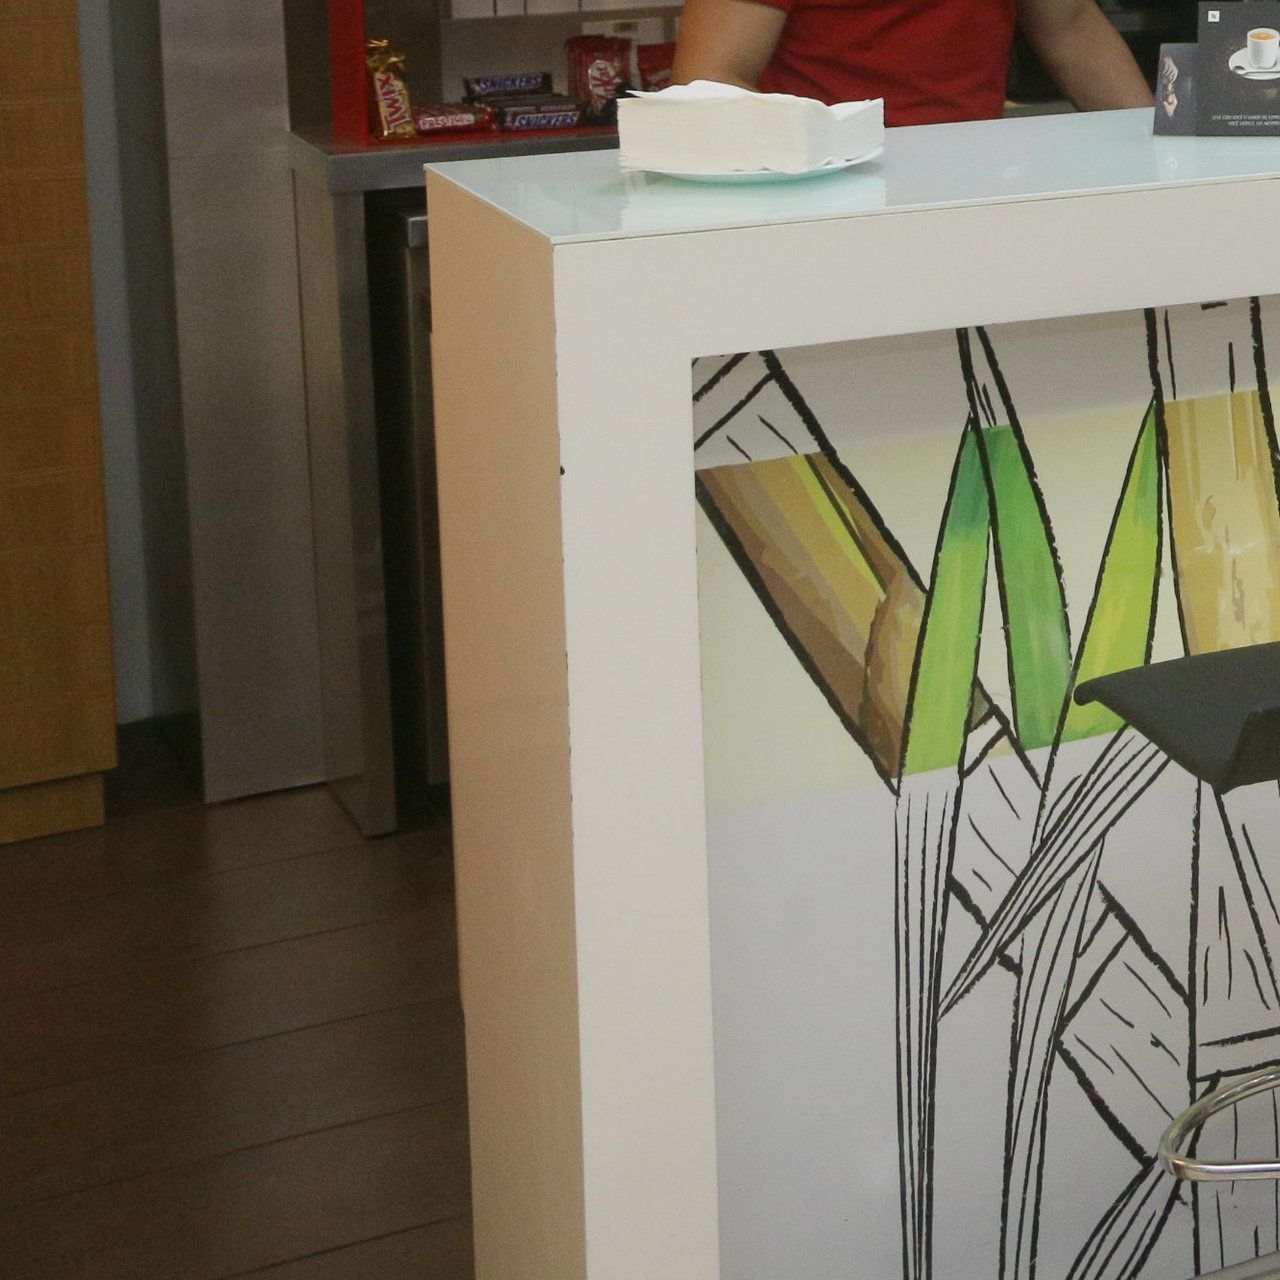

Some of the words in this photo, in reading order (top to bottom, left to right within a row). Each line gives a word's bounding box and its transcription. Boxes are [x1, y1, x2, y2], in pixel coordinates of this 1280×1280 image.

[479, 74, 542, 94] SNICKERS
[378, 72, 409, 133] TWIX
[517, 111, 580, 130] SNICKERS
